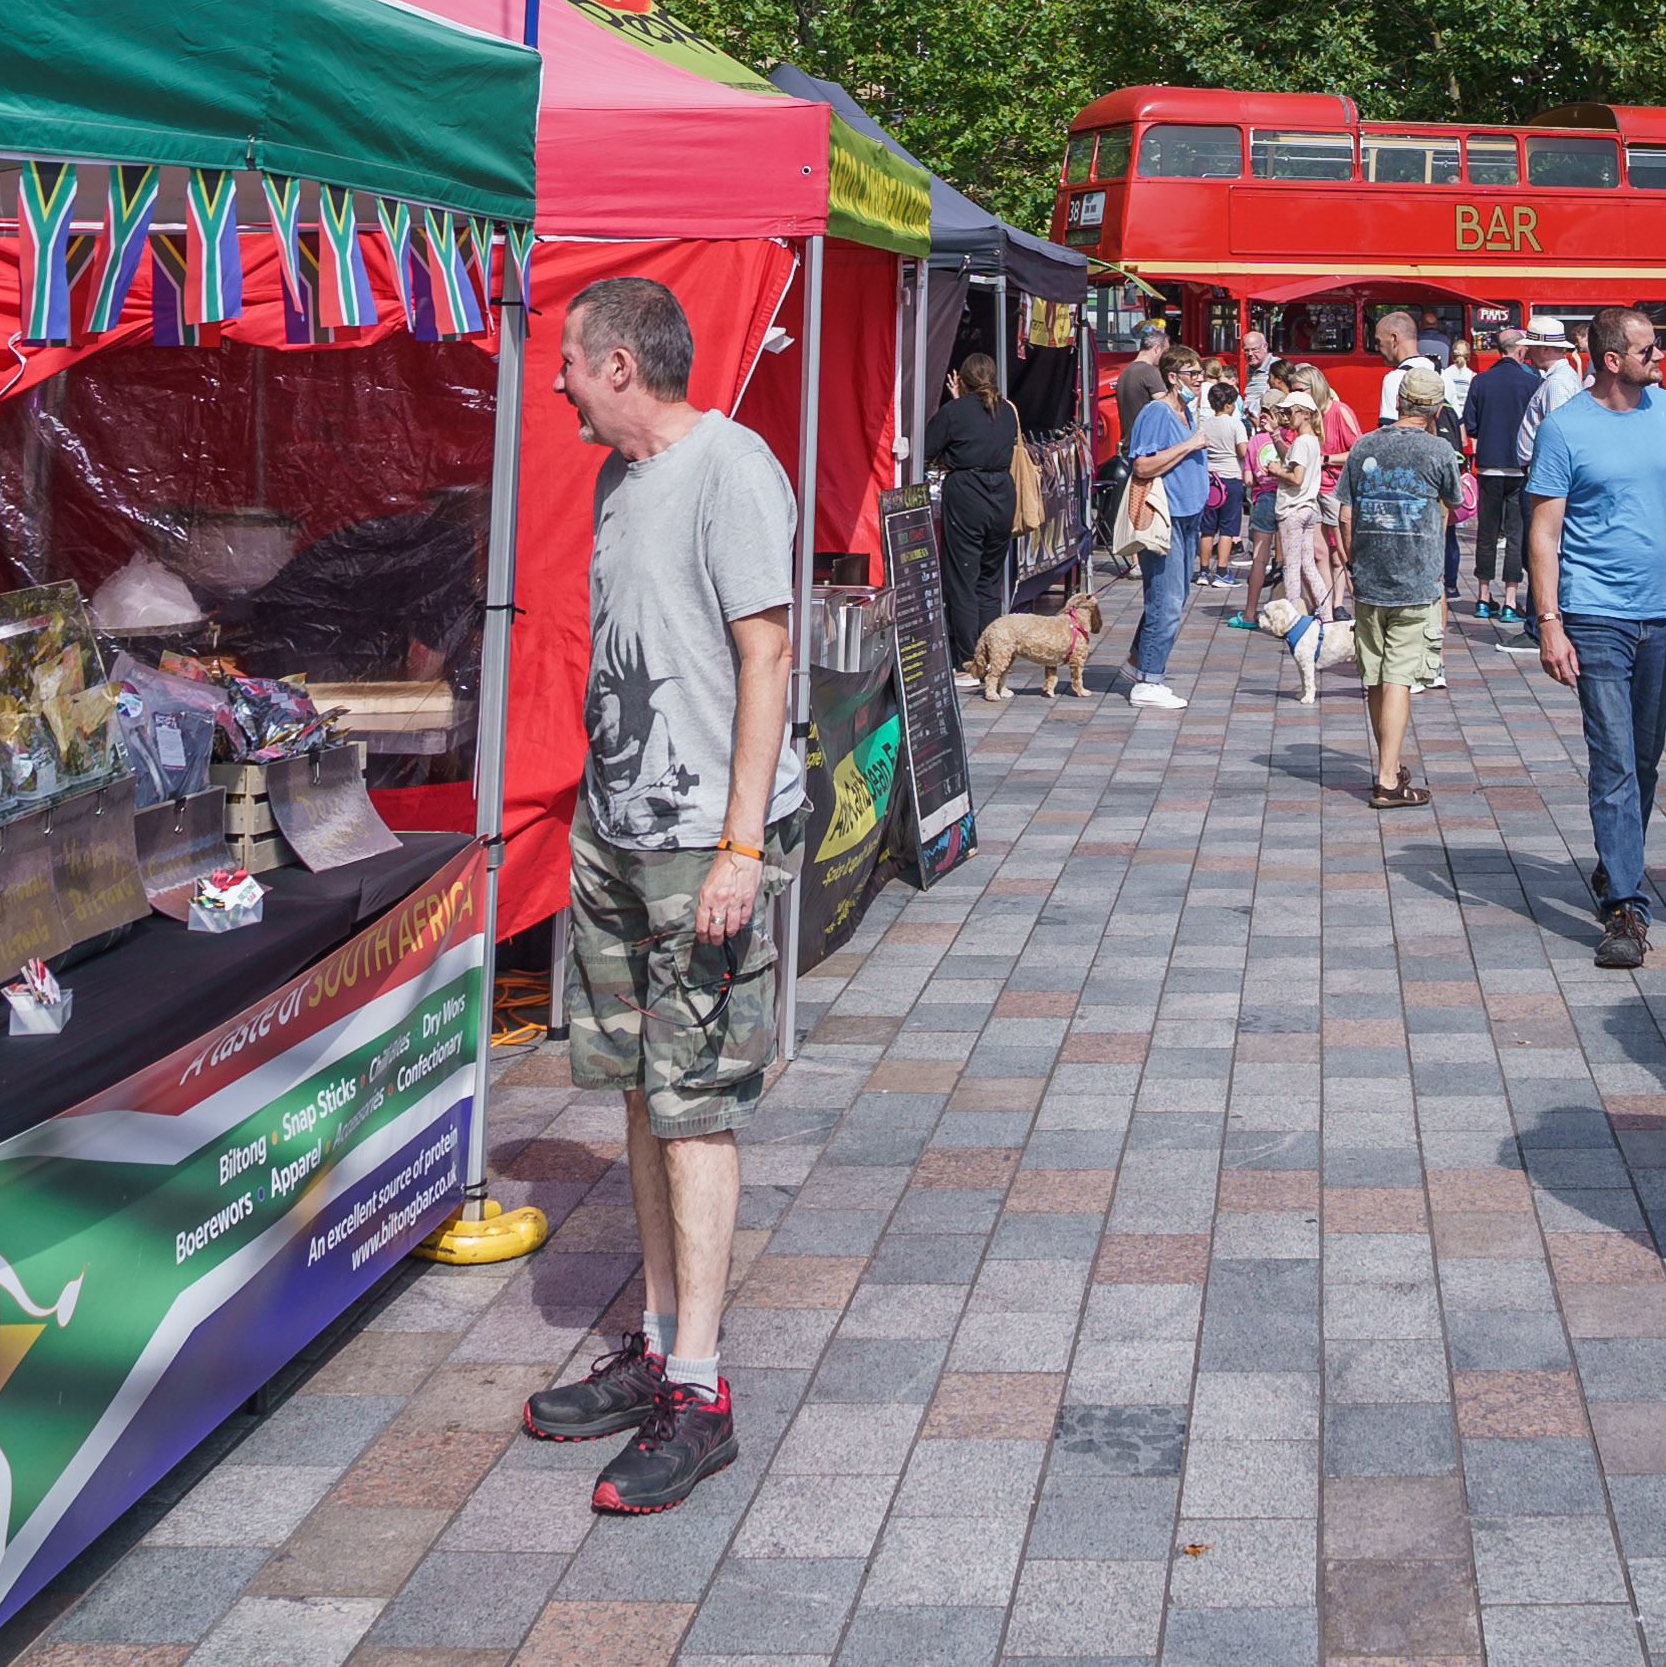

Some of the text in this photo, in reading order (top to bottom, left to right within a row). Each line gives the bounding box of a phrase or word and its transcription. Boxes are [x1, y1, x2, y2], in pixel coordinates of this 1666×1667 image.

[1068, 200, 1081, 222] 38
[1455, 204, 1544, 252] BAR
[307, 918, 393, 1009] SOUTH
[397, 875, 474, 954] AFRICA
[175, 1191, 254, 1265] Boerewors
[270, 1138, 322, 1198] Apparel
[397, 1030, 463, 1093] Confectionary
[219, 994, 466, 1187] Biltong Snap Sticks Dry Wors
[307, 1125, 459, 1268] An excellent source of protein
[351, 1167, 458, 1271] www.biltongbar.co.uk
